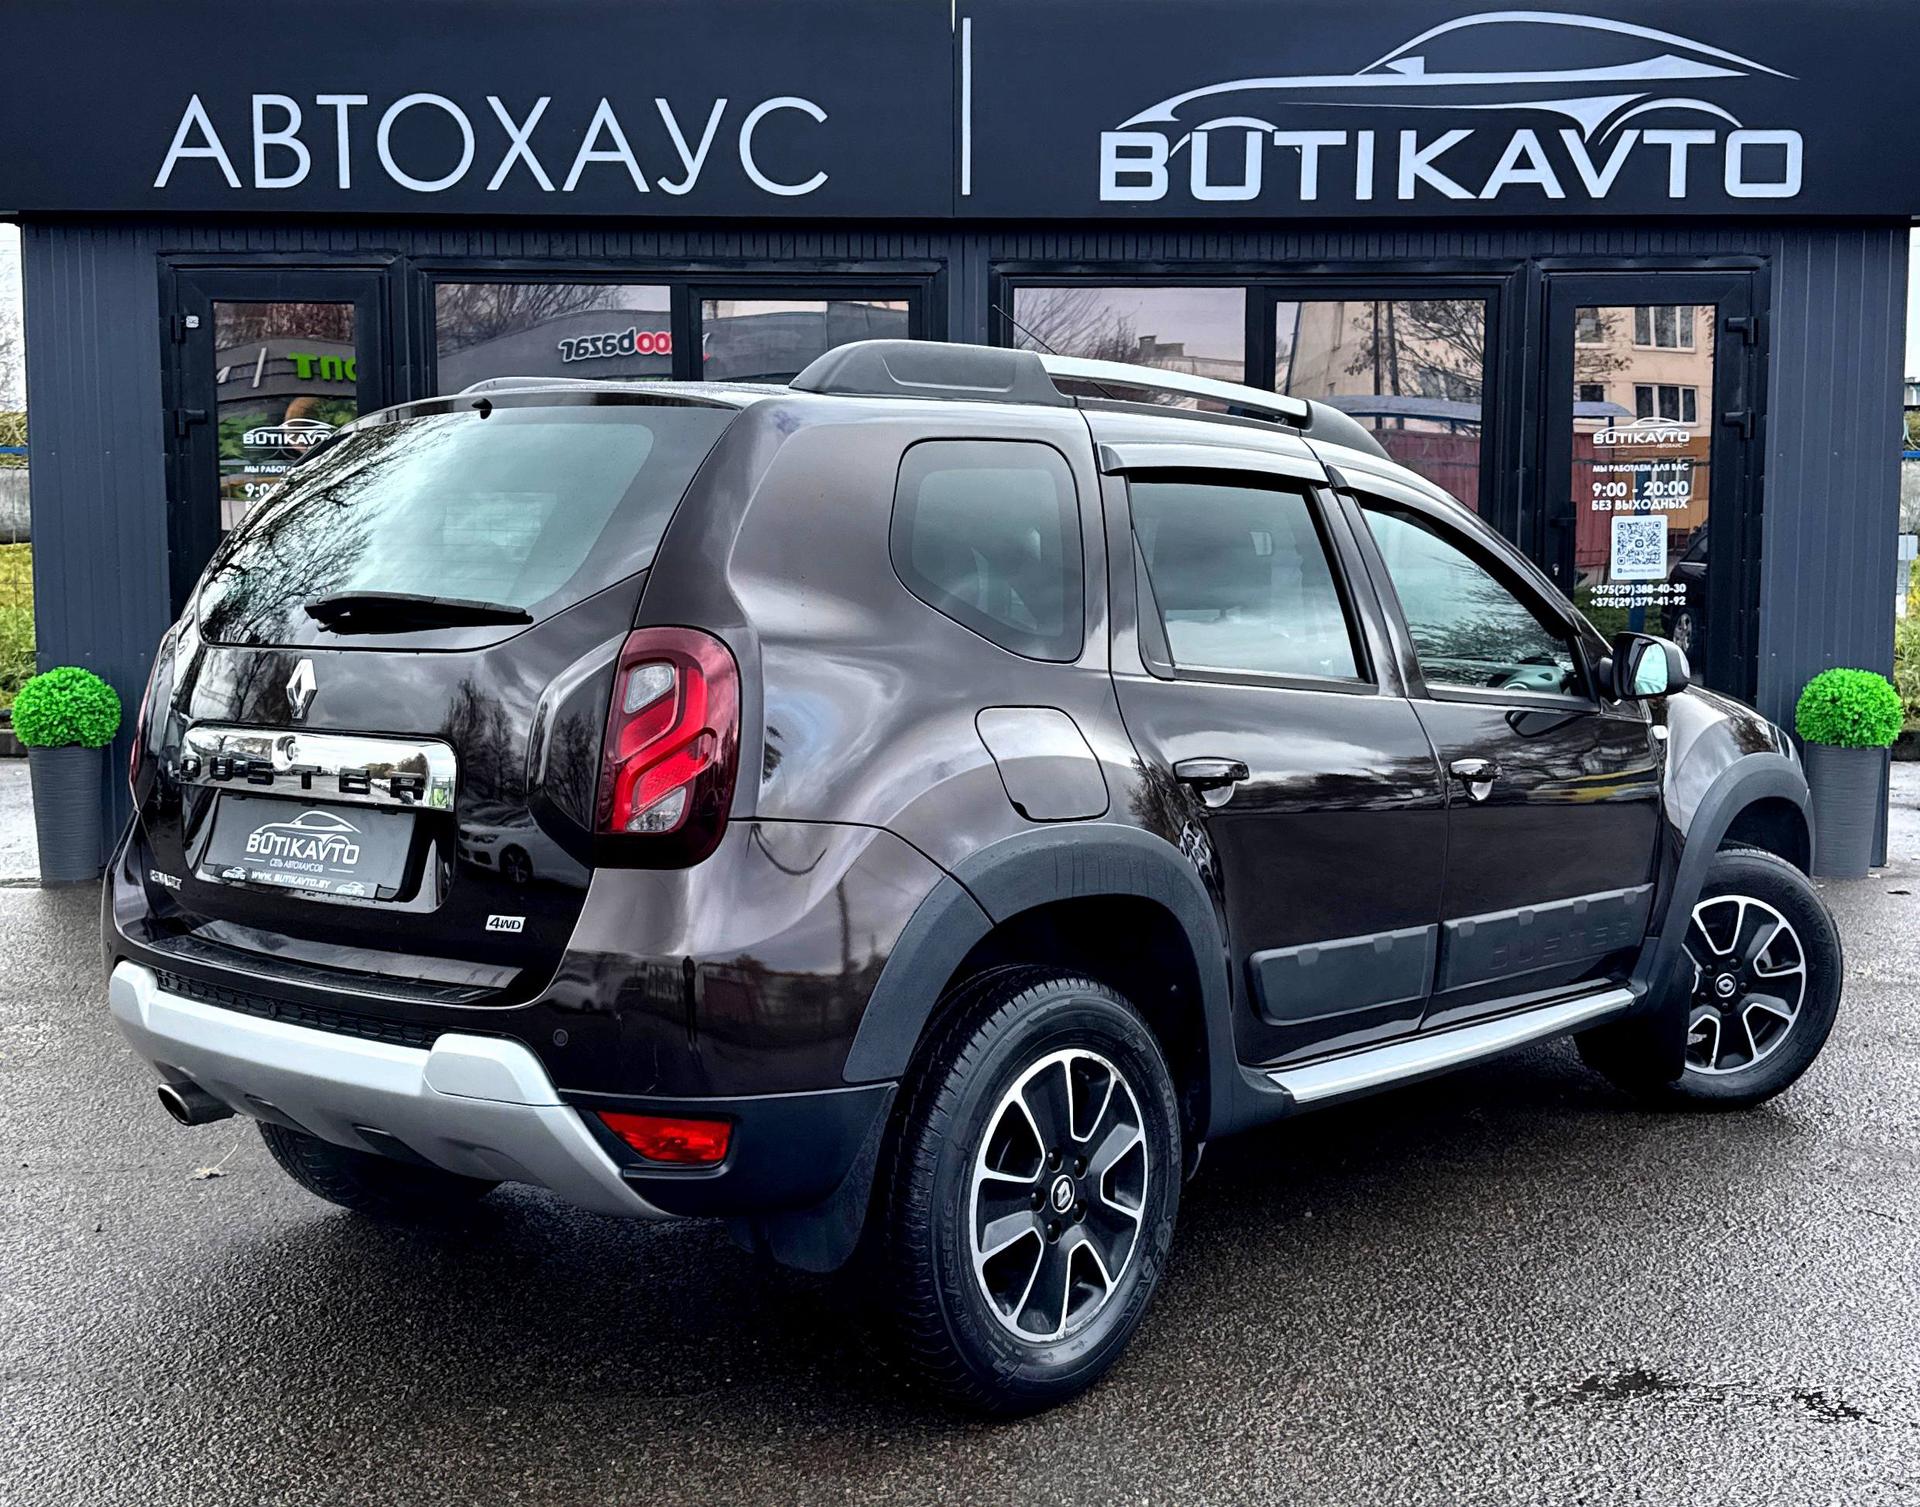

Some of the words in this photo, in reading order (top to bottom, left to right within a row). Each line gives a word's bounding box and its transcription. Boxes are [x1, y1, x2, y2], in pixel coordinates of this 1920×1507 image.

[154, 92, 829, 197] АВТОХАУС
[1099, 129, 1805, 203] BUTIKAVTO
[242, 432, 329, 446] BUTIKAVT
[1592, 431, 1690, 444] BUTIKAVTO
[244, 465, 259, 473] МЫ
[260, 465, 291, 473] РАБОТ
[1592, 465, 1607, 473] МЫ
[1608, 464, 1651, 473] РАБОТАЕМ
[1652, 464, 1670, 472] ДЛЯ
[1671, 463, 1689, 471] ВАС
[244, 482, 271, 498] 9:0
[1592, 482, 1627, 497] 9:00
[1643, 481, 1689, 496] 20:00
[1591, 500, 1612, 511] БЕЗ
[1614, 499, 1688, 511] ВЫХОДНЫХ
[1590, 583, 1687, 596] +375(29)388-40-30
[1590, 596, 1686, 608] +375(29)379-41-92
[179, 755, 425, 800] DUSTER
[246, 832, 360, 865] BUTIKAVTO
[273, 872, 331, 889] BUTIKAVTO.BY
[488, 916, 522, 930] 4WD
